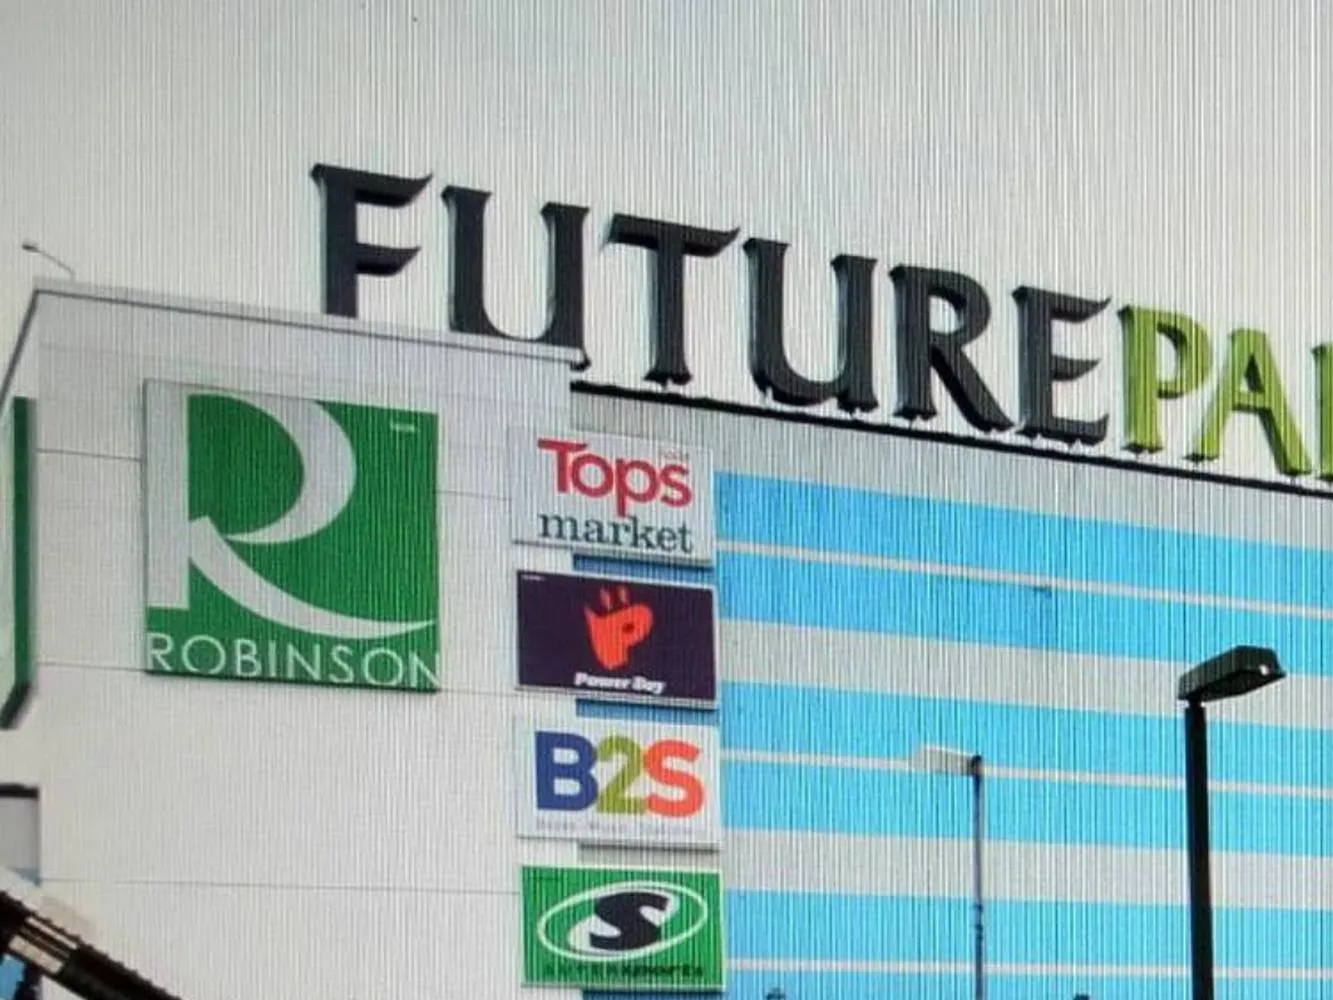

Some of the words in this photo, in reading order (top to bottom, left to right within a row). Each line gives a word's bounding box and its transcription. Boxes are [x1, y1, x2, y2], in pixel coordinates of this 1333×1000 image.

[538, 437, 693, 518] Tops
[538, 513, 694, 554] market
[149, 631, 440, 689] ROBINSON
[534, 730, 706, 818] B2S
